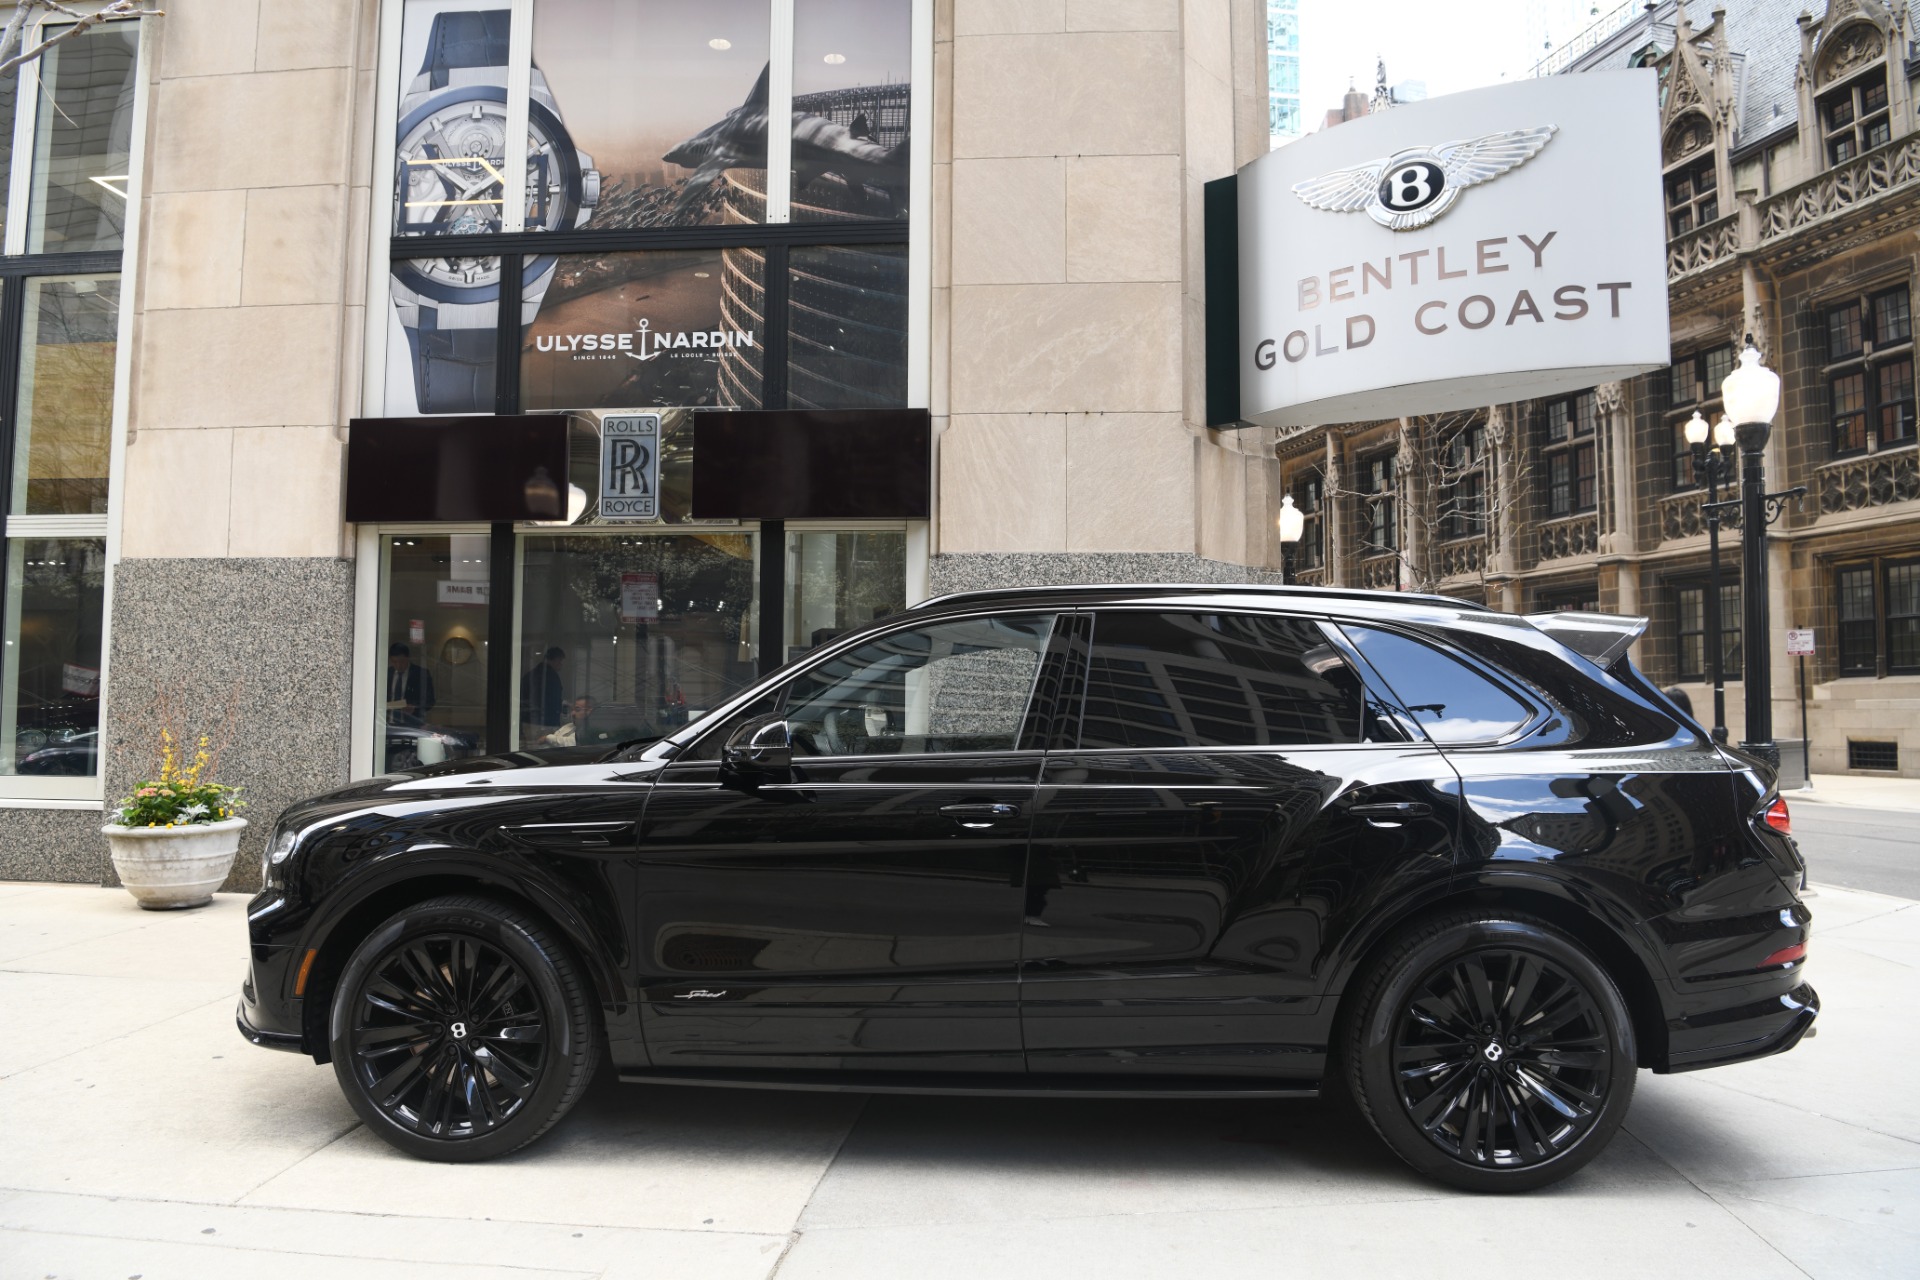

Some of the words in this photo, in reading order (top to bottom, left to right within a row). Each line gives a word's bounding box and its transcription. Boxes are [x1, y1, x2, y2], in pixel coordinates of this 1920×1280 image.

[1297, 231, 1558, 312] BENTLEY
[1254, 313, 1376, 371] GOLD
[1414, 282, 1632, 336] COAST
[536, 333, 633, 352] ULYSSE
[653, 330, 753, 349] NARDIN
[607, 420, 653, 433] ROLLS
[605, 500, 651, 513] ROYCE
